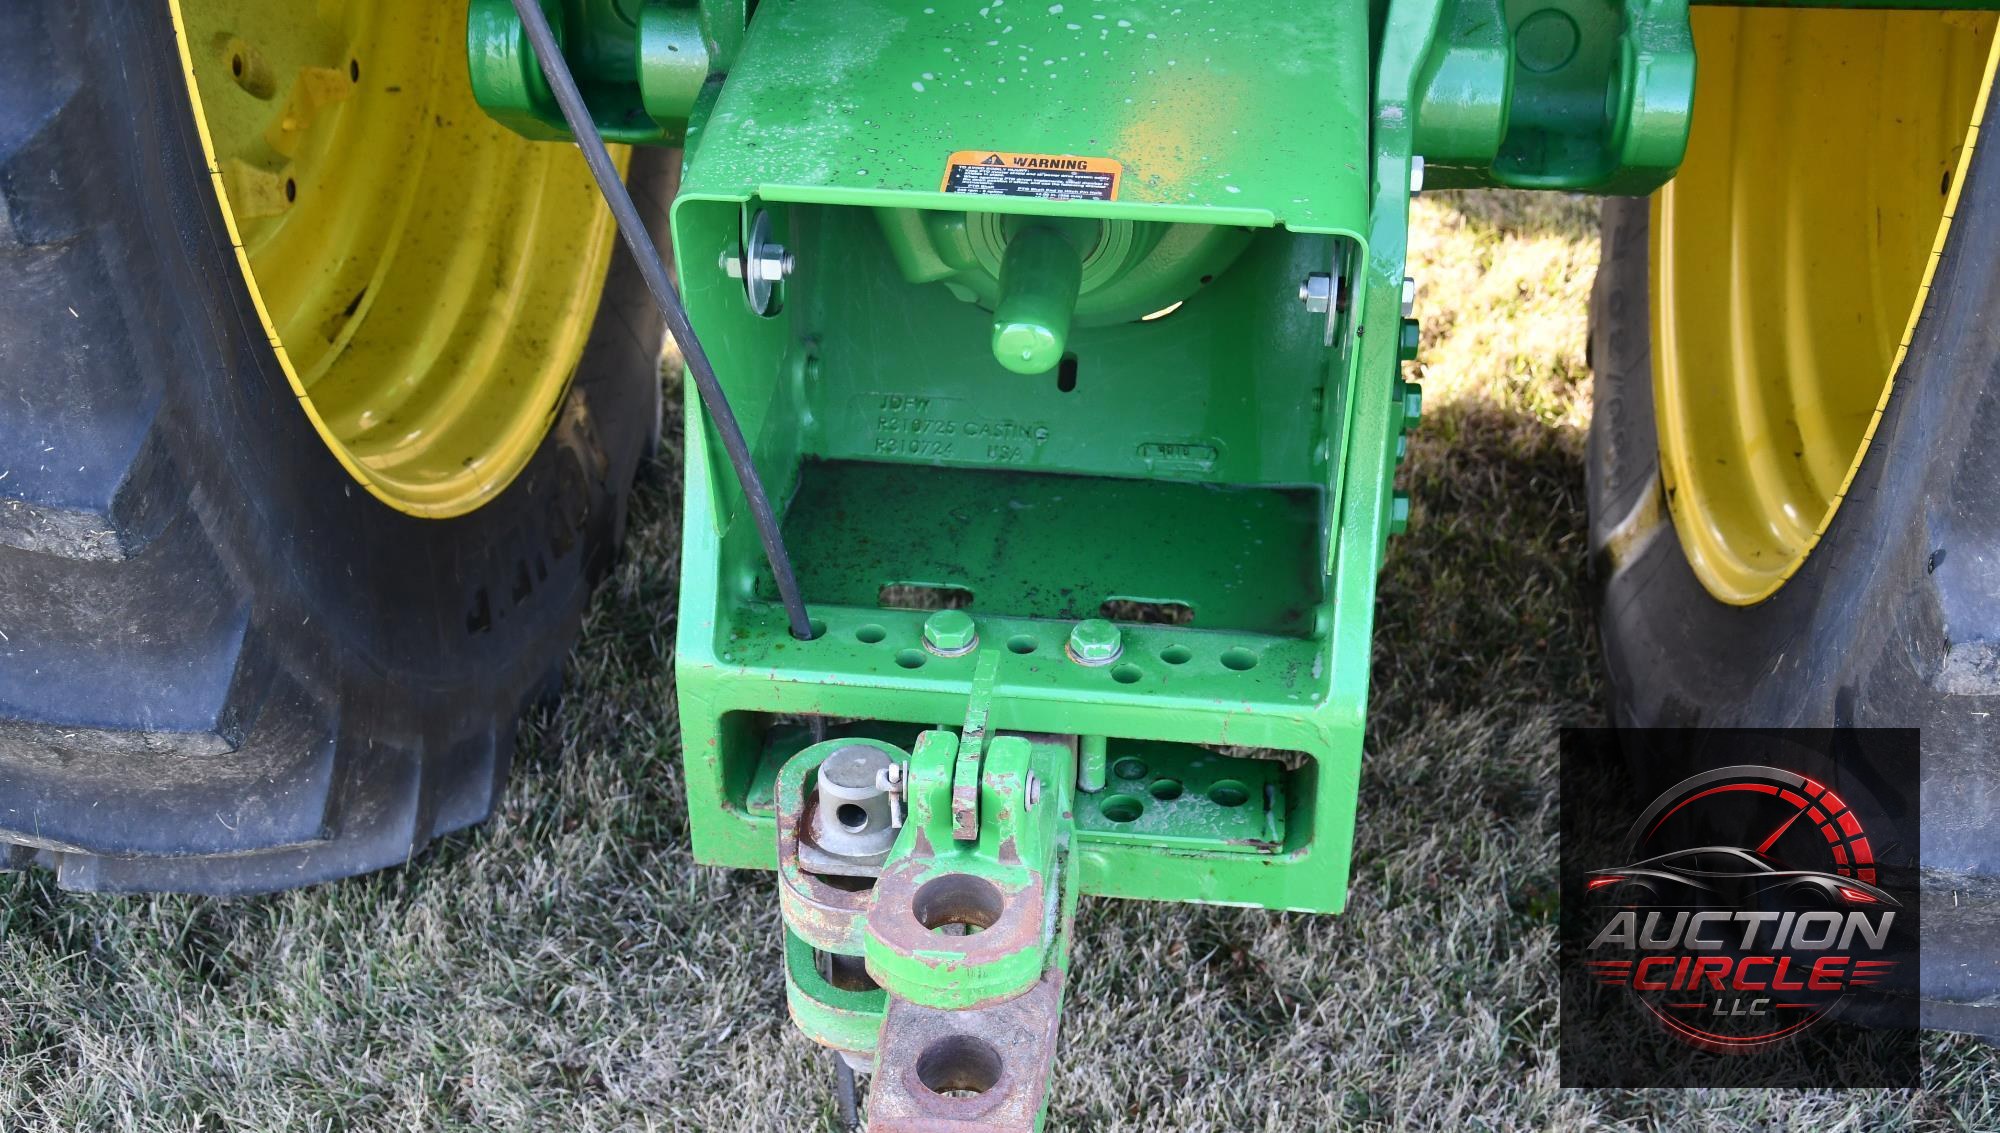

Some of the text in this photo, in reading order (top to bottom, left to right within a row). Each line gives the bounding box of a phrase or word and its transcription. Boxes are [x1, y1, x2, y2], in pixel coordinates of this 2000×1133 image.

[1013, 156, 1088, 171] WARNING
[963, 421, 1050, 443] CASTING
[986, 444, 1024, 461] USA
